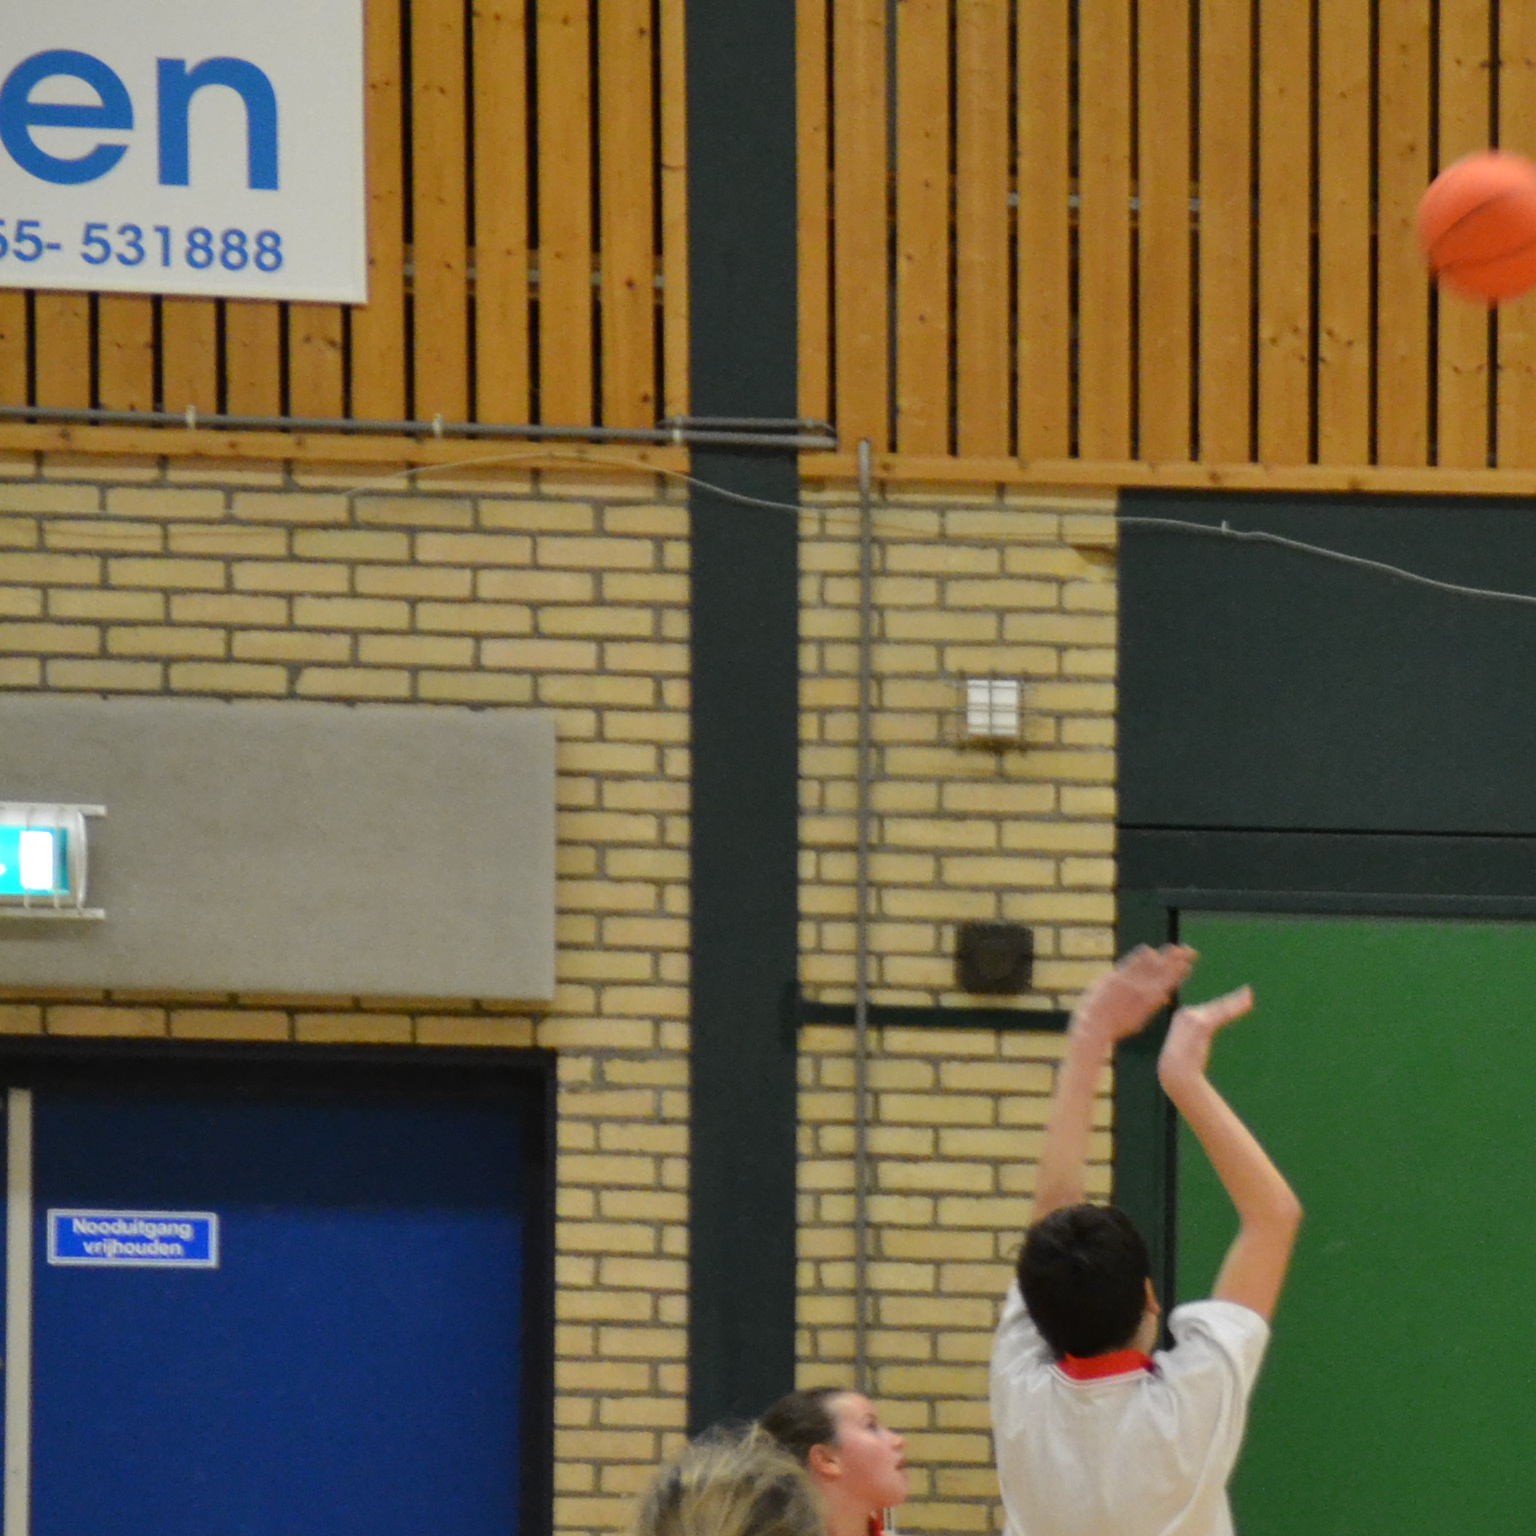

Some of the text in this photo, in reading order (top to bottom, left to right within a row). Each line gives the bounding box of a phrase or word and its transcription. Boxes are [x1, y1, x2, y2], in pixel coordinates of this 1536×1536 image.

[0, 48, 279, 191] en
[0, 218, 284, 273] 5- 531888
[72, 1217, 194, 1241] Nooduitgang
